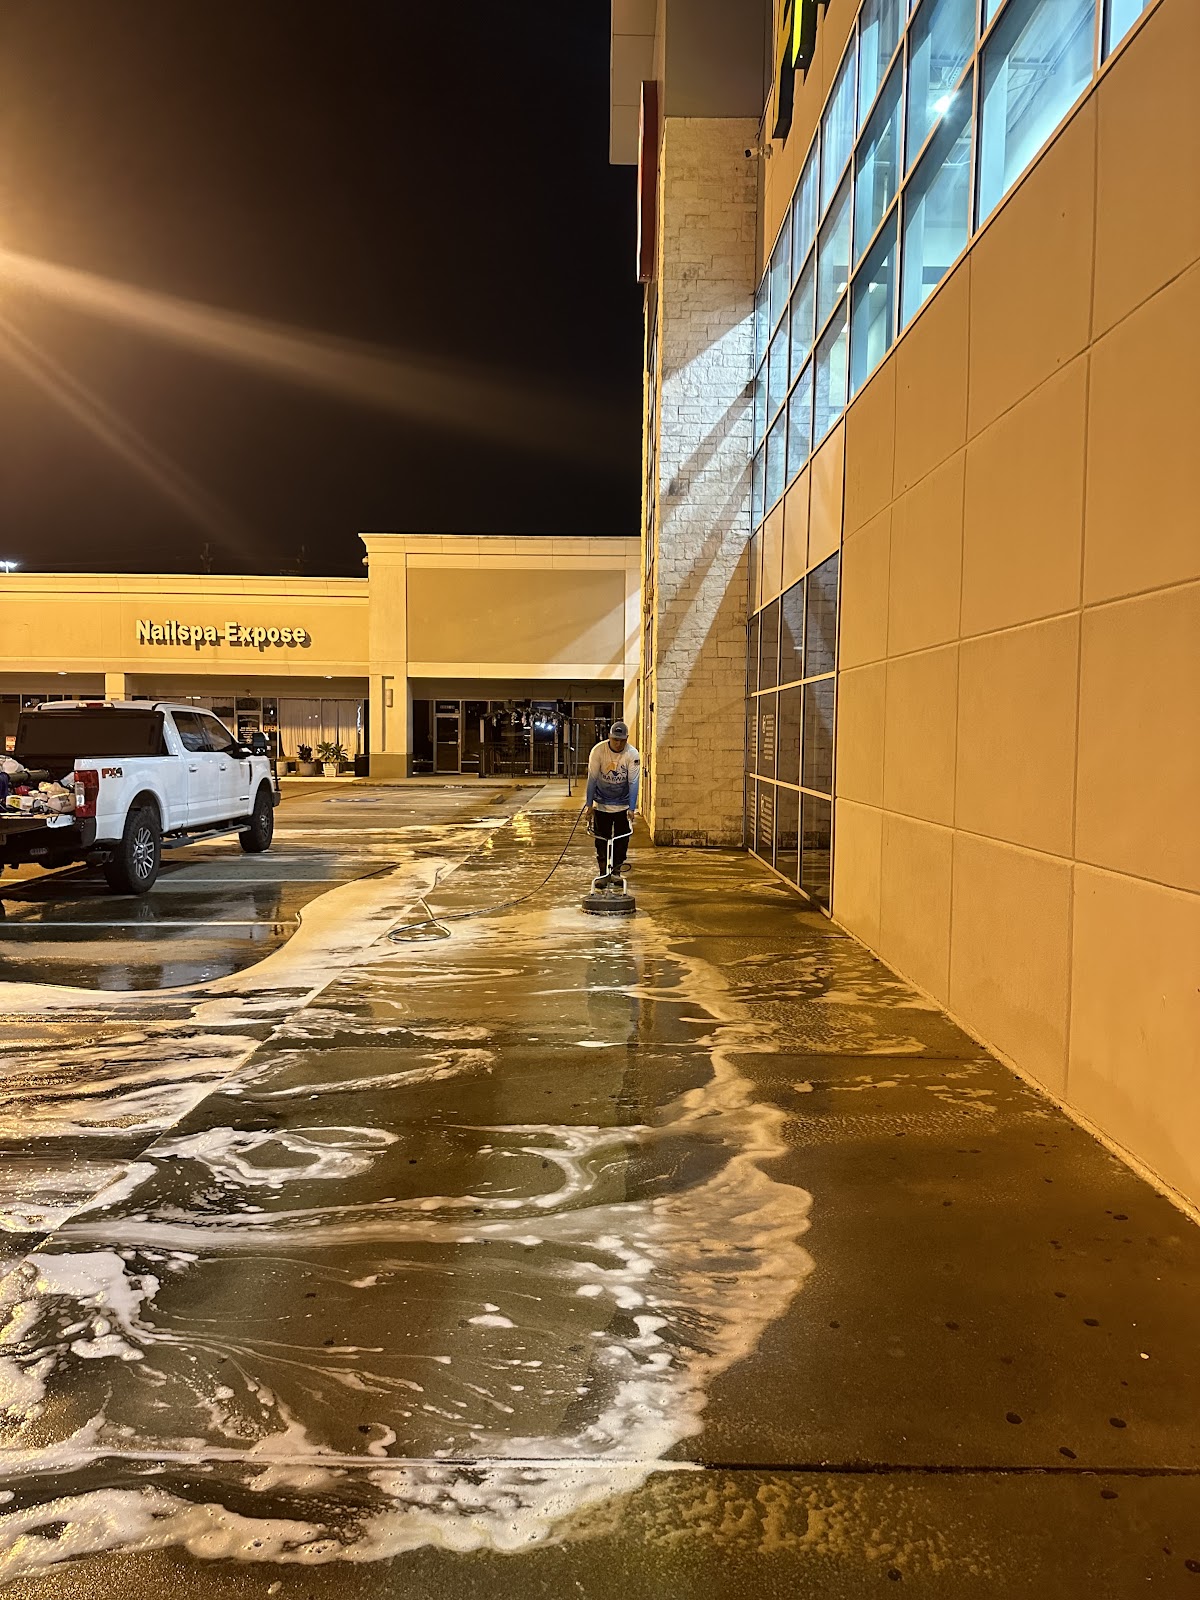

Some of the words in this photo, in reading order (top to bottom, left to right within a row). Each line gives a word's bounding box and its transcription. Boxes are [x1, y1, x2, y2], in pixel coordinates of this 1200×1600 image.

[135, 619, 217, 645] Nailspa
[224, 621, 306, 647] Expose
[263, 724, 277, 732] OPEN
